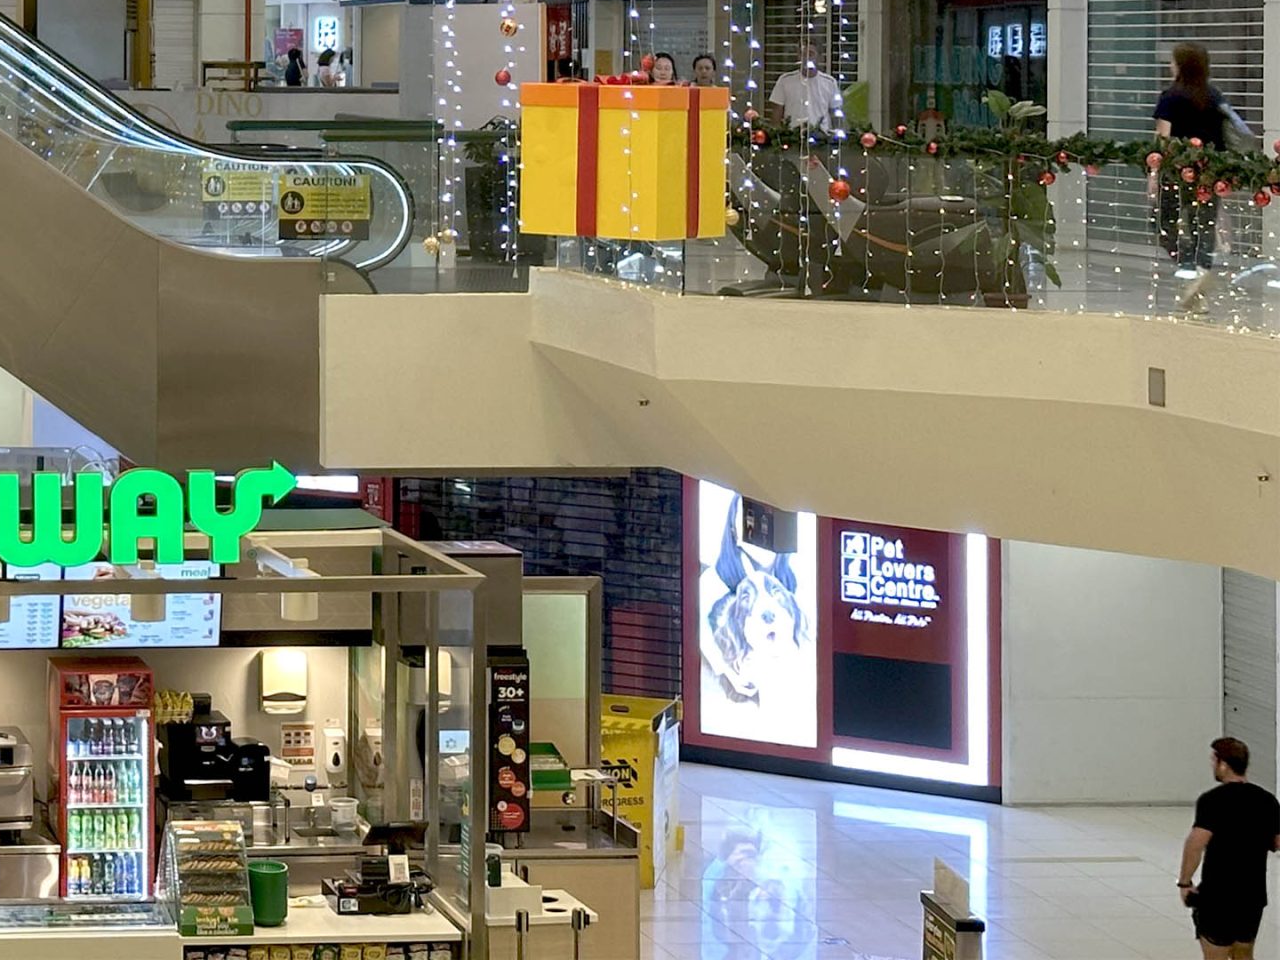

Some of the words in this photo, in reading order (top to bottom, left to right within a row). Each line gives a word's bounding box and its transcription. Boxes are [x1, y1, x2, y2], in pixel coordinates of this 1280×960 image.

[195, 94, 263, 117] DINO
[293, 176, 357, 188] CAUTION!
[871, 536, 903, 558] Pet
[181, 567, 211, 577] meal
[871, 556, 935, 582] Lovers
[494, 672, 527, 683] freestyle
[498, 686, 524, 699] 30+
[602, 796, 644, 807] ROGRESS
